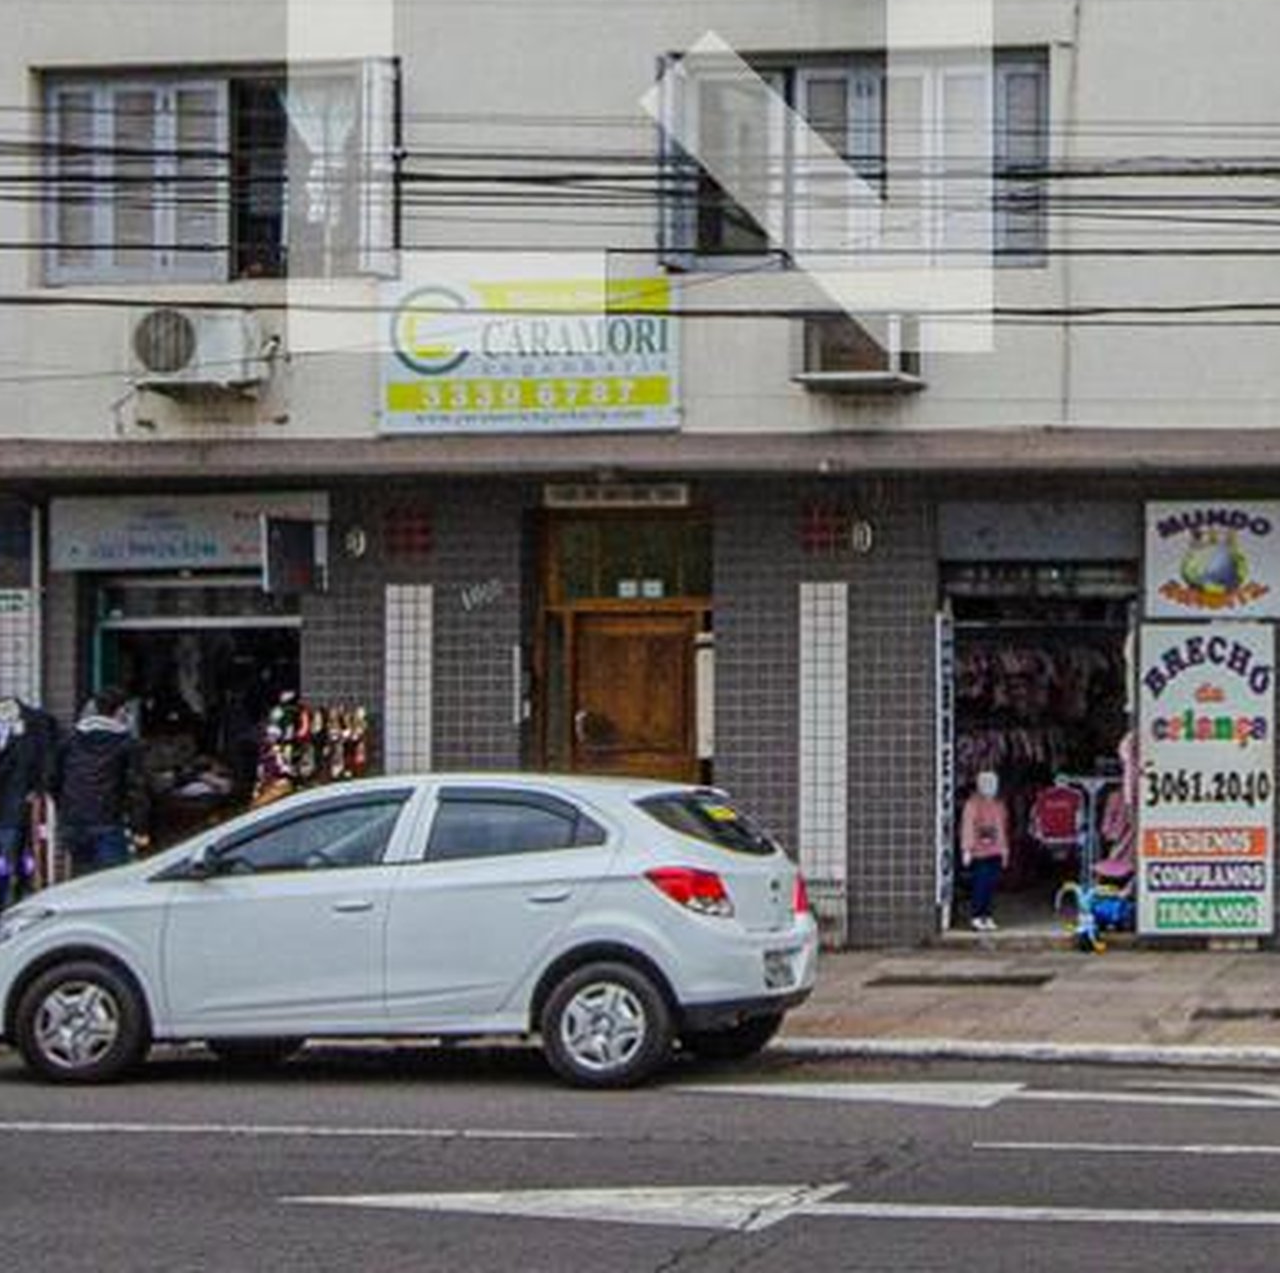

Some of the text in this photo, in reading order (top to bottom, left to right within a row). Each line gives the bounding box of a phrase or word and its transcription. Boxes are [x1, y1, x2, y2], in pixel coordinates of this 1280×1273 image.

[482, 317, 668, 357] CARAMORI
[1156, 509, 1273, 538] MUNDO
[1144, 635, 1272, 699] BRECHÓ
[1148, 864, 1265, 888] COMPRAMOS
